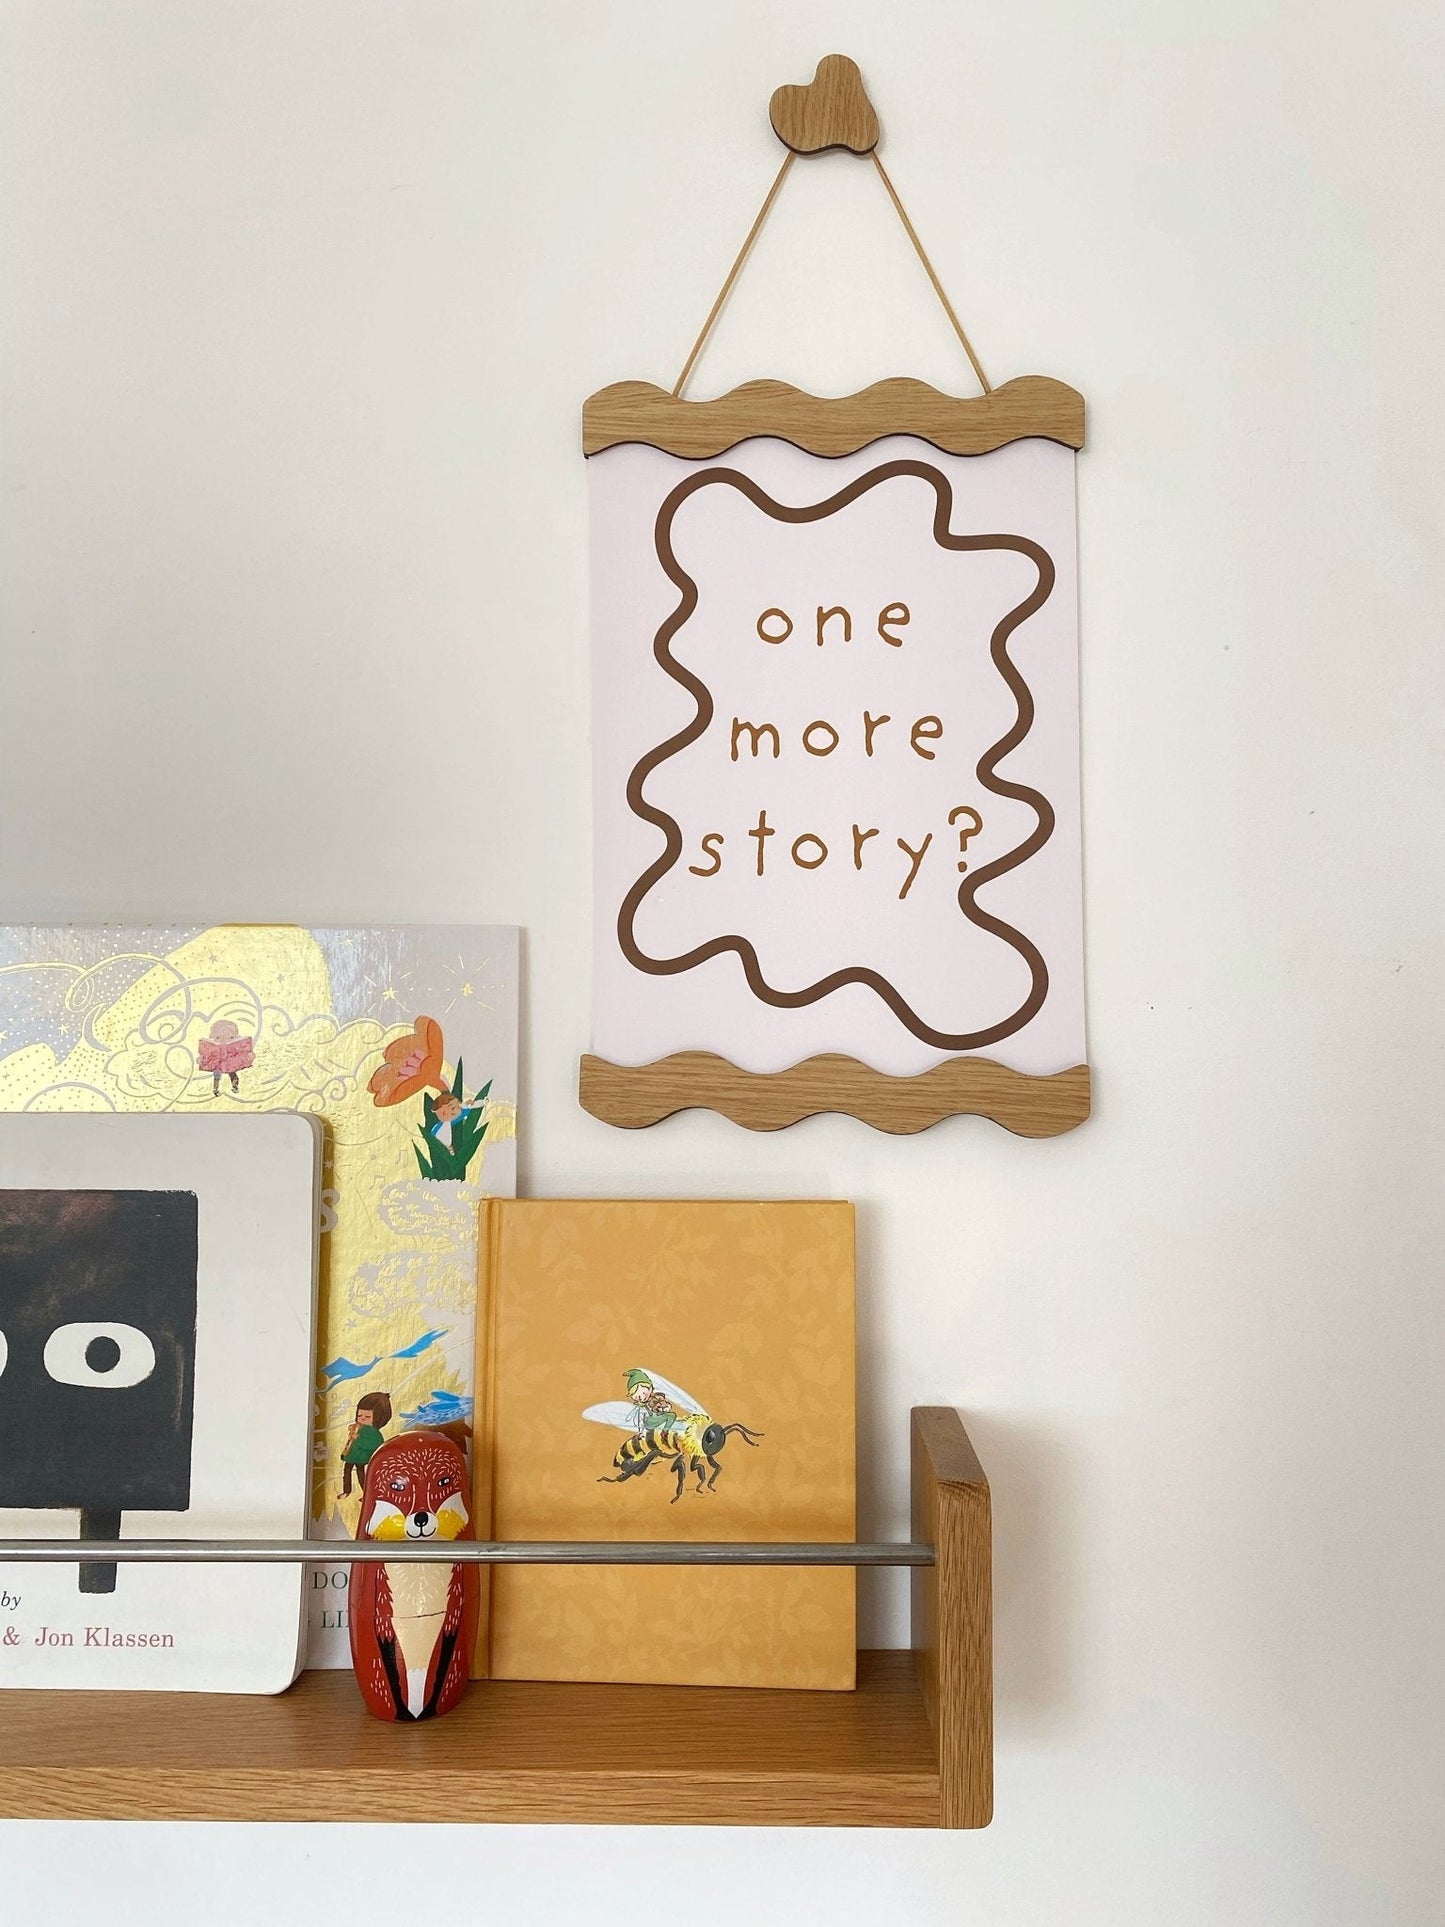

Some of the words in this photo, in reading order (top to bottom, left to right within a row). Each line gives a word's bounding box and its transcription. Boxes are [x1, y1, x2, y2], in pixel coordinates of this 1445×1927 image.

[756, 602, 911, 648] one
[731, 711, 944, 761] more
[688, 805, 984, 899] story?
[0, 1591, 22, 1611] by
[321, 1610, 349, 1629] LI
[2, 1626, 20, 1646] &
[34, 1627, 74, 1647] Jon
[83, 1627, 175, 1648] Klassen
